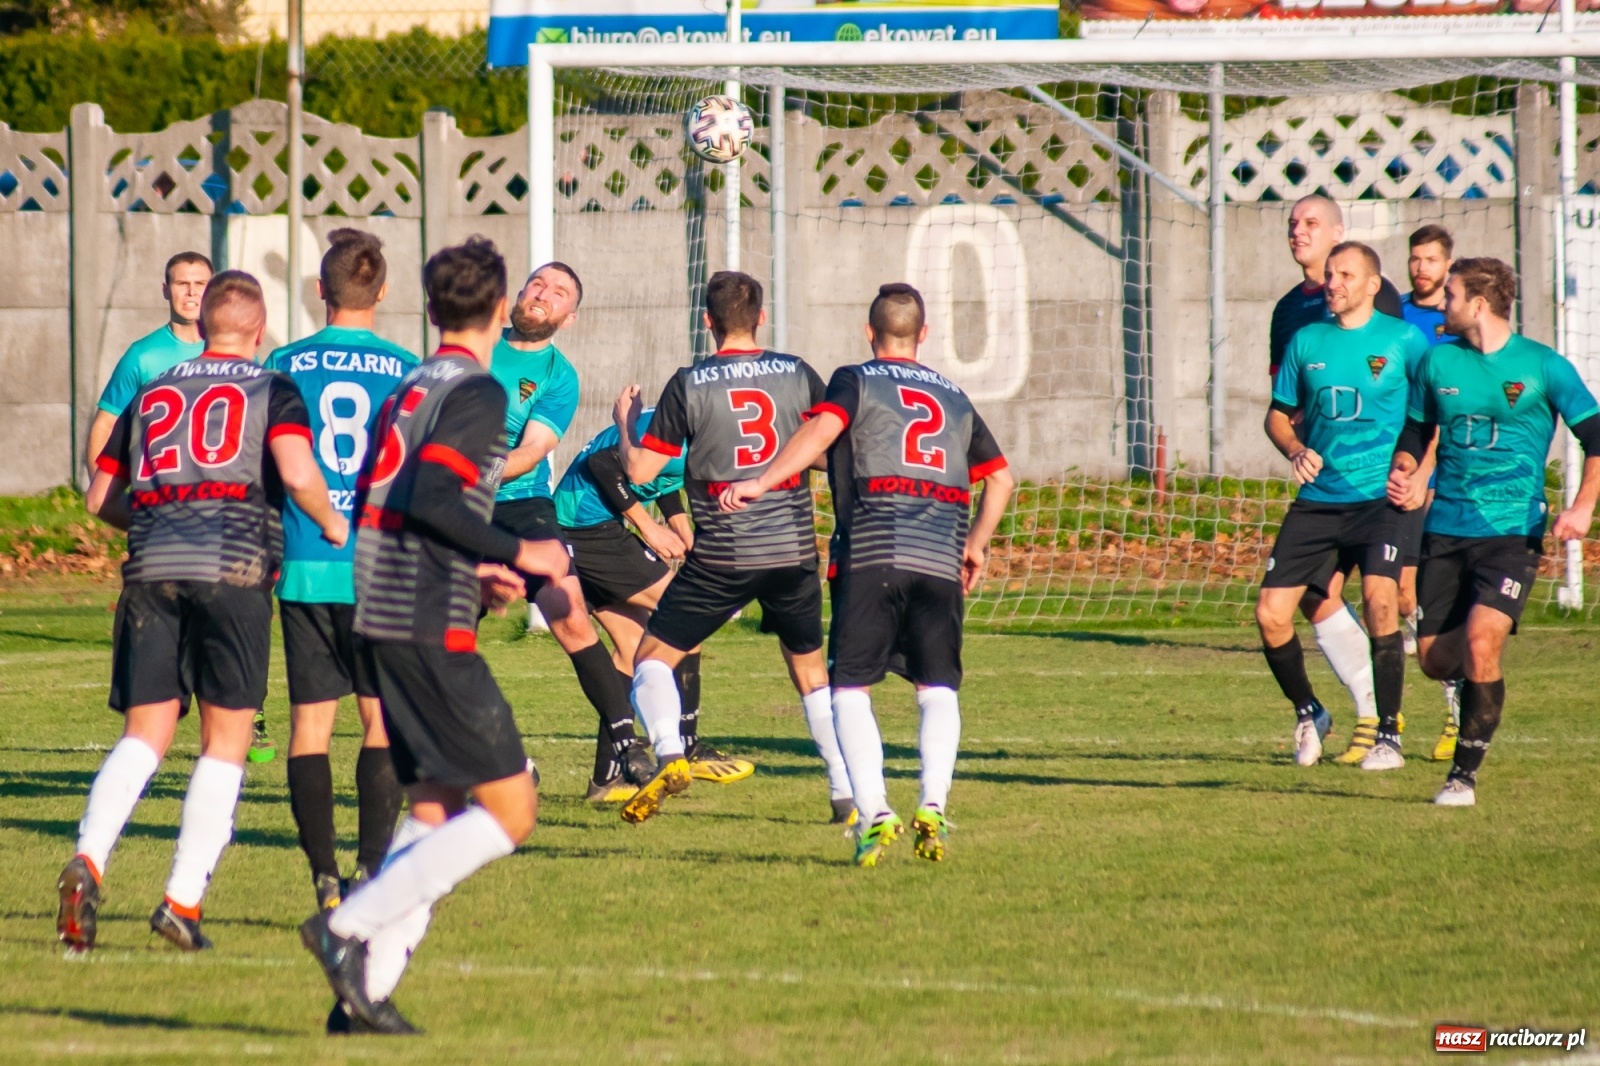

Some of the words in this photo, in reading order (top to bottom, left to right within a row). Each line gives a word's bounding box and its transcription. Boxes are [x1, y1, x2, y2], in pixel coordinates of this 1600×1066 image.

[571, 26, 791, 43] biuro@ekowteu
[864, 24, 997, 41] ekowateu
[1576, 208, 1600, 229] U
[289, 351, 318, 372] KS
[322, 350, 402, 377] CZARNI
[692, 366, 719, 385] LKS
[721, 358, 796, 380] TWORKÓW
[137, 382, 248, 481] 20
[319, 381, 371, 475] 8
[727, 388, 779, 469] 3
[897, 385, 946, 474] 2
[1384, 543, 1398, 562] 17
[1501, 577, 1521, 600] 20
